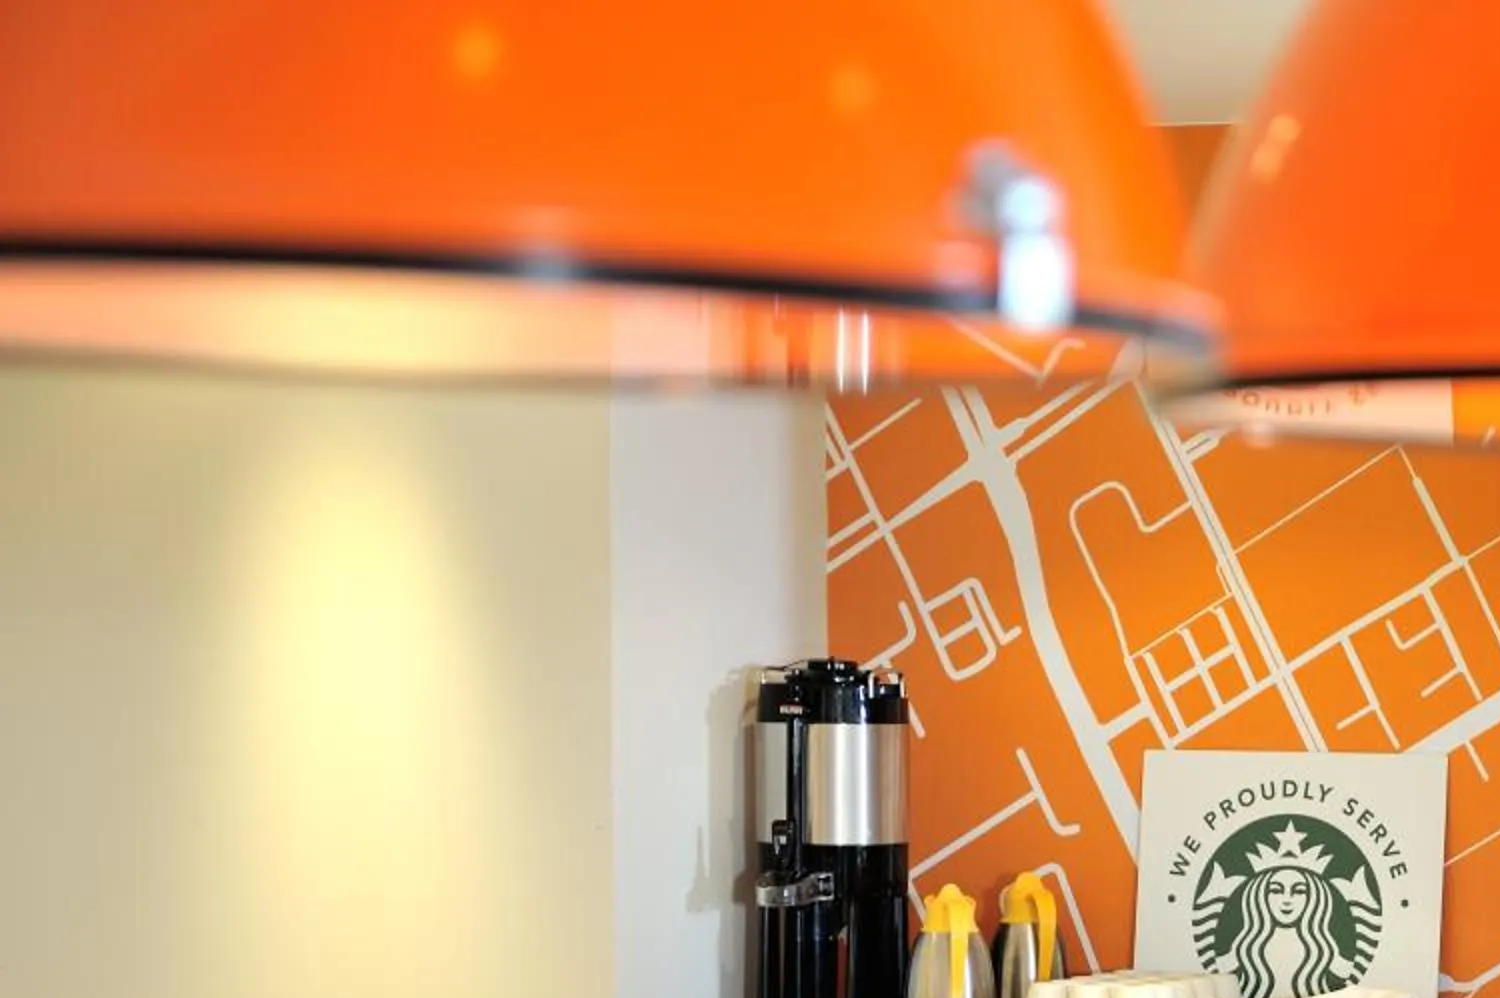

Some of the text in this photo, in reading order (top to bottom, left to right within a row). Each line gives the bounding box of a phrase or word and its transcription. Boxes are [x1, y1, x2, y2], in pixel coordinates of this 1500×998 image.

[1169, 779, 1408, 879] WE PROUDLY SERVE
